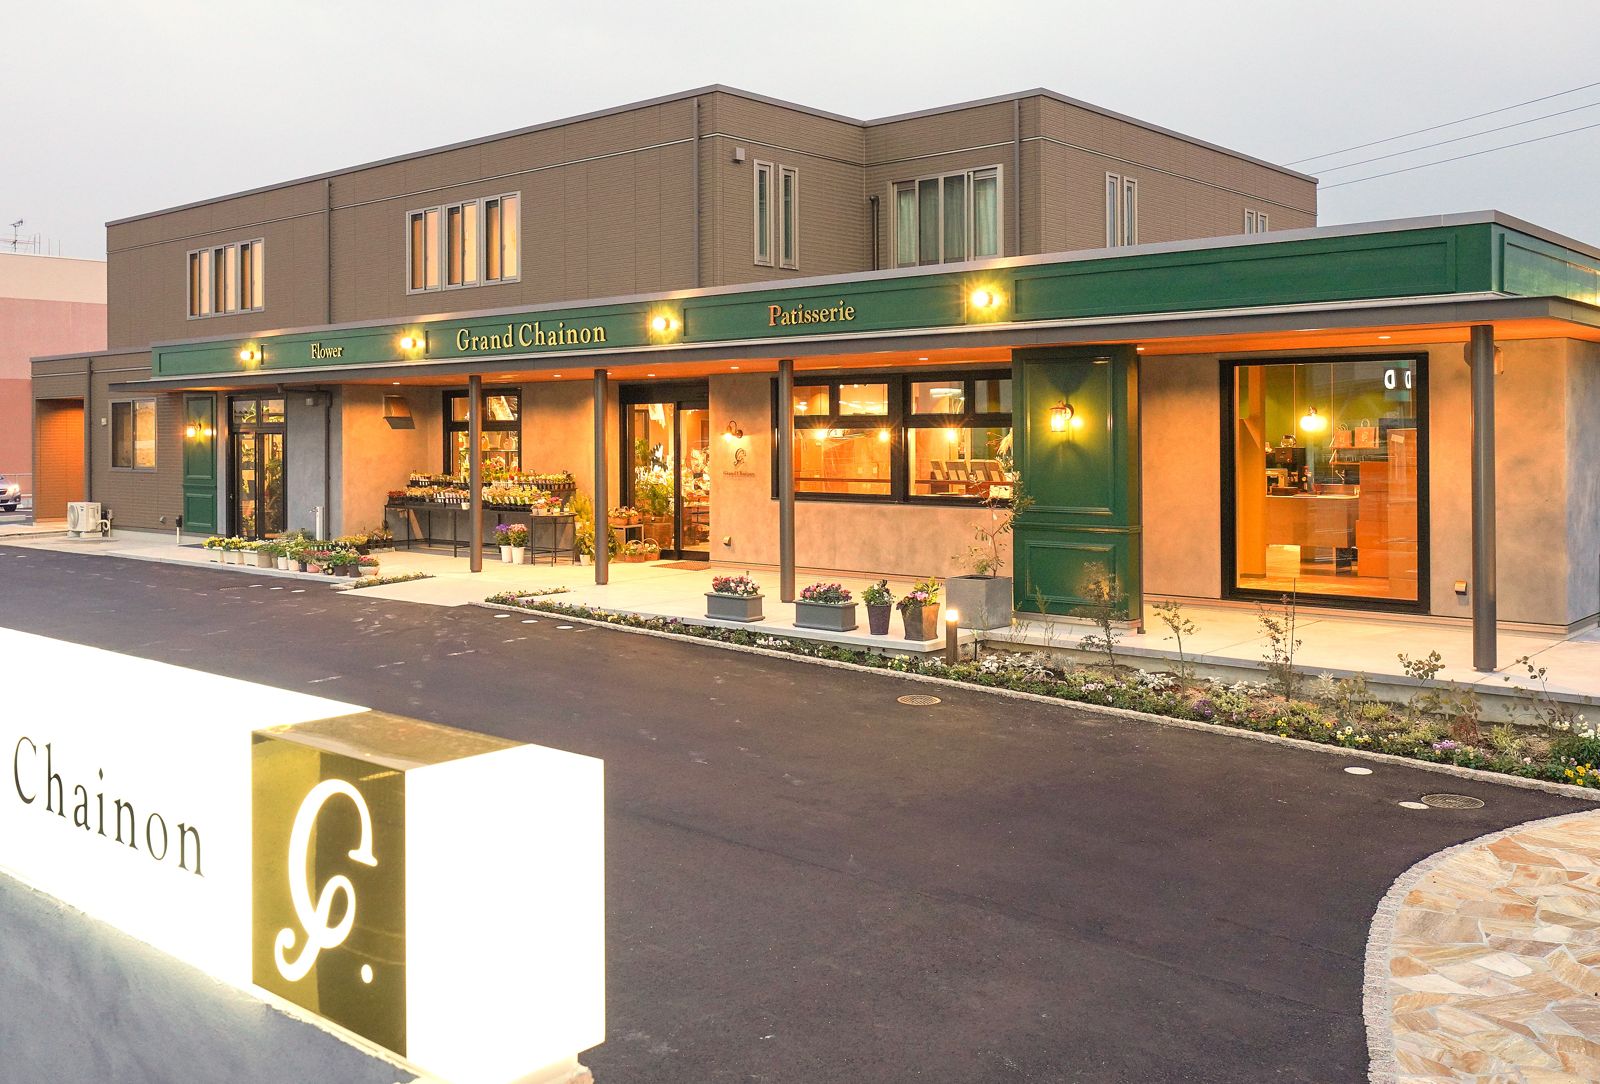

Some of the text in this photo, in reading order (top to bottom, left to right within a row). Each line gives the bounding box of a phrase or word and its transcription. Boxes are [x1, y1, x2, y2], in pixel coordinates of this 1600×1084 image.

[767, 299, 855, 327] Patisserie
[310, 342, 344, 359] Flower
[455, 321, 607, 351] Grand Chainon
[13, 736, 205, 878] Chainon
